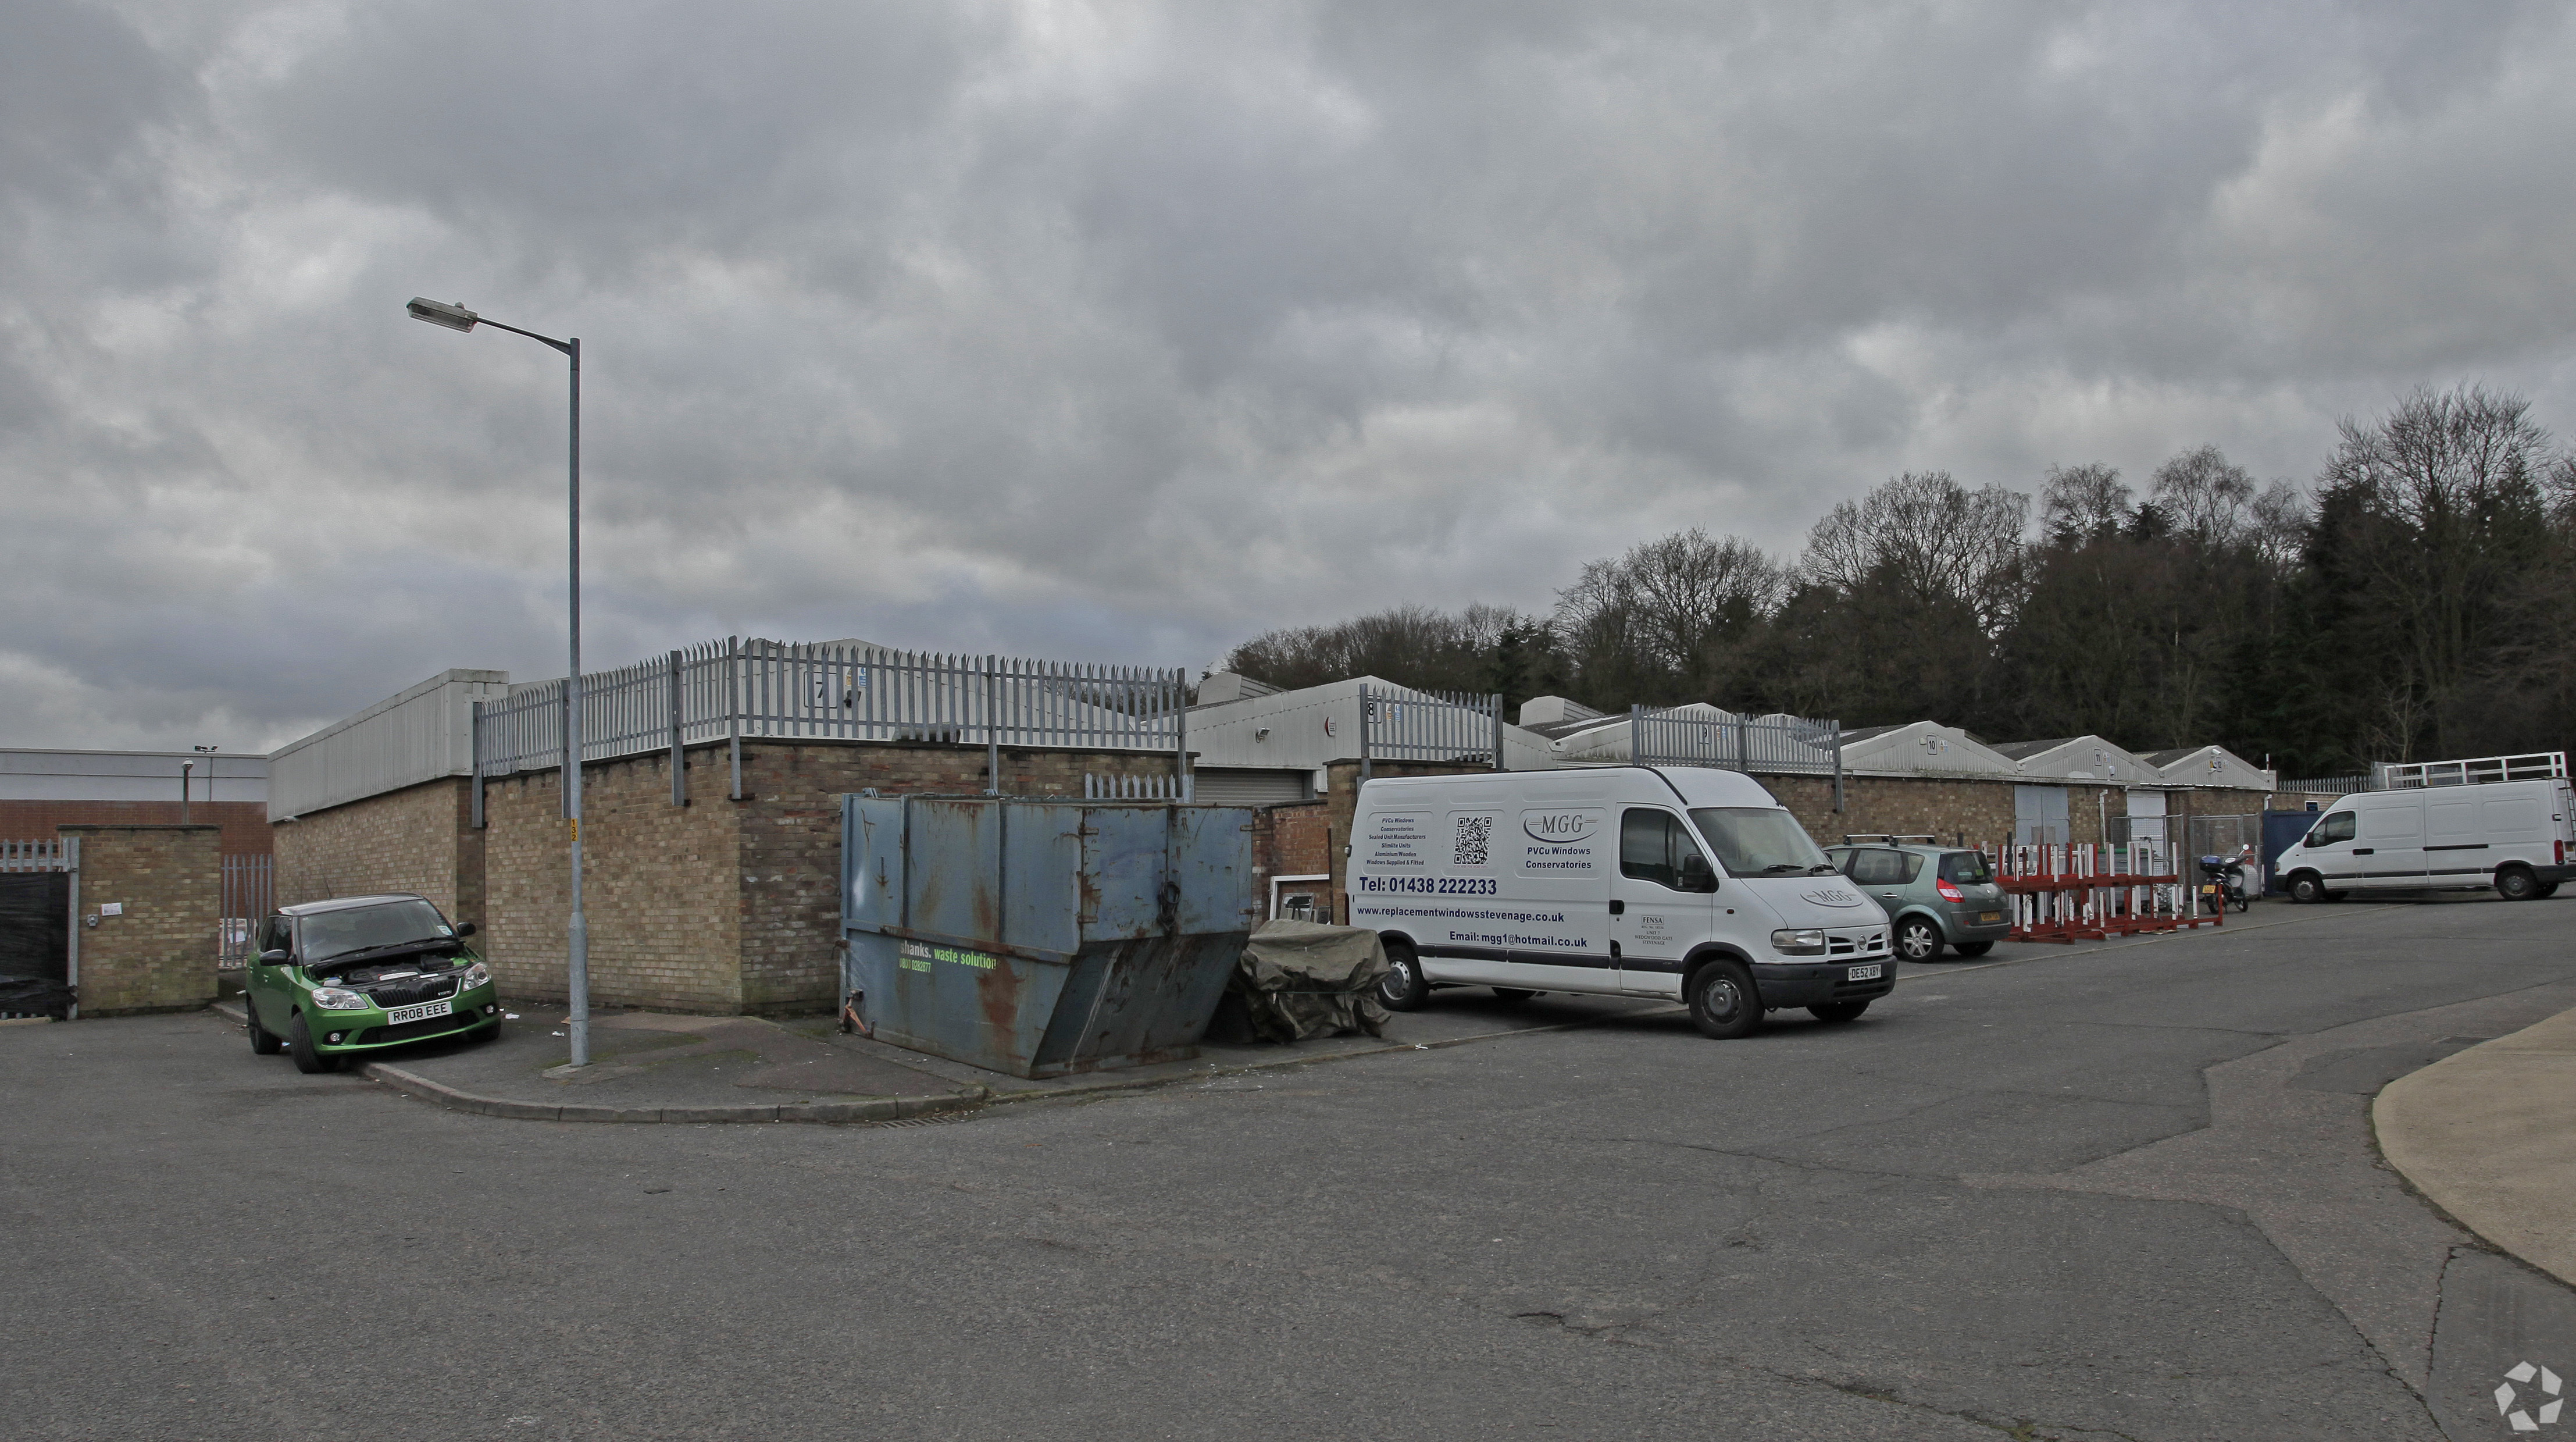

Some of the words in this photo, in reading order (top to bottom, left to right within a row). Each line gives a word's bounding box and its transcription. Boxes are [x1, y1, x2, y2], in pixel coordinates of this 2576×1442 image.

[1368, 702, 1374, 716] 8
[1929, 740, 1935, 750] 10
[2096, 753, 2100, 762] 11
[1541, 814, 1583, 834] MGG
[1527, 847, 1550, 855] PVCu
[1551, 847, 1590, 855] Windows
[1526, 860, 1592, 868] Conservatories
[1359, 877, 1386, 892] Tel:
[1389, 877, 1435, 893] 01438
[1438, 878, 1497, 895] 222233
[1812, 890, 1852, 902] MGG
[1357, 907, 1565, 923] www.replacementwindowsstevenage.co.uk
[1450, 931, 1479, 942] Email:
[1482, 933, 1587, 948] mgg1@hotmail.co.uk
[934, 948, 958, 964] waste
[1851, 968, 1868, 978] DE52
[1869, 966, 1879, 977] XBY
[393, 1008, 423, 1021] RR08
[426, 1003, 447, 1016] EEE
